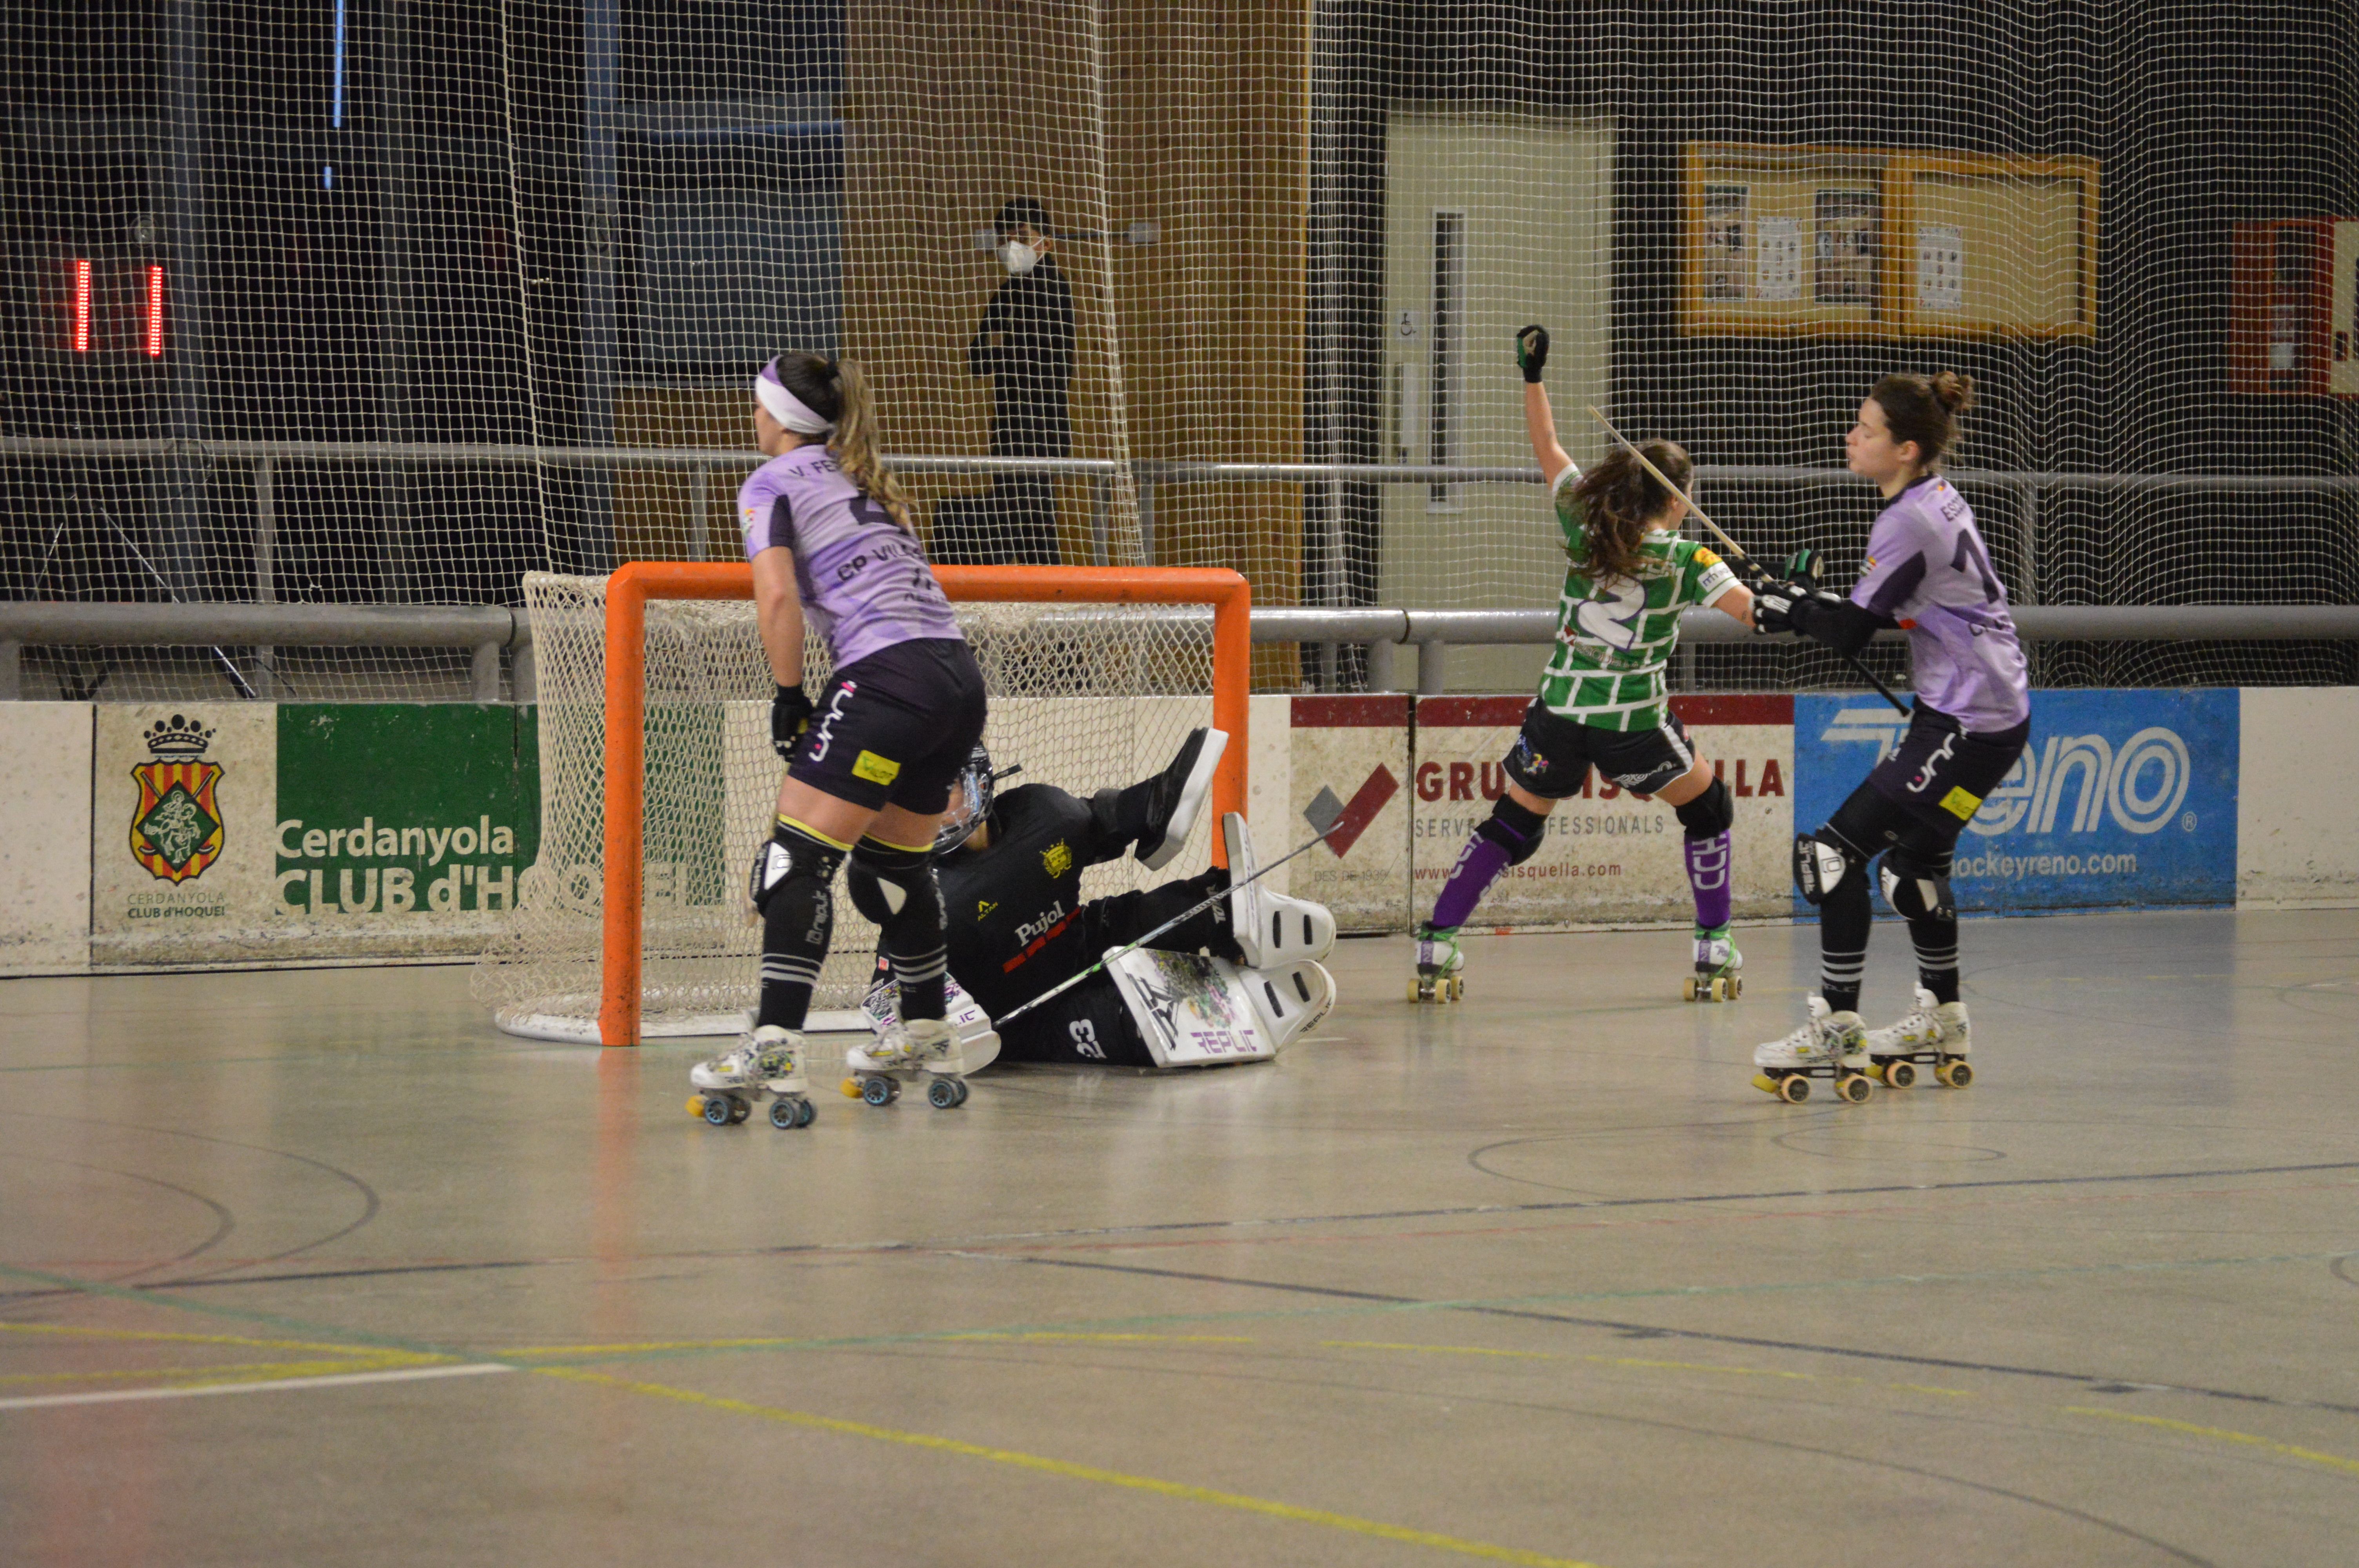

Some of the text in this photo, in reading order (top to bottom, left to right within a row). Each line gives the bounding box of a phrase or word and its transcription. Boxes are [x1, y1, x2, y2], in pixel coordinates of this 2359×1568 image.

[1577, 572, 1647, 652] 2
[275, 815, 514, 866] Cerdanyola
[275, 867, 416, 914] CLUB
[1314, 870, 1337, 882] DES
[128, 892, 225, 904] CERDANYOLA
[128, 906, 225, 918] CLUB d'HOQUEI
[1014, 900, 1065, 947] Pujol
[1069, 1019, 1107, 1058] 23
[1191, 1030, 1257, 1054] REPLIC
